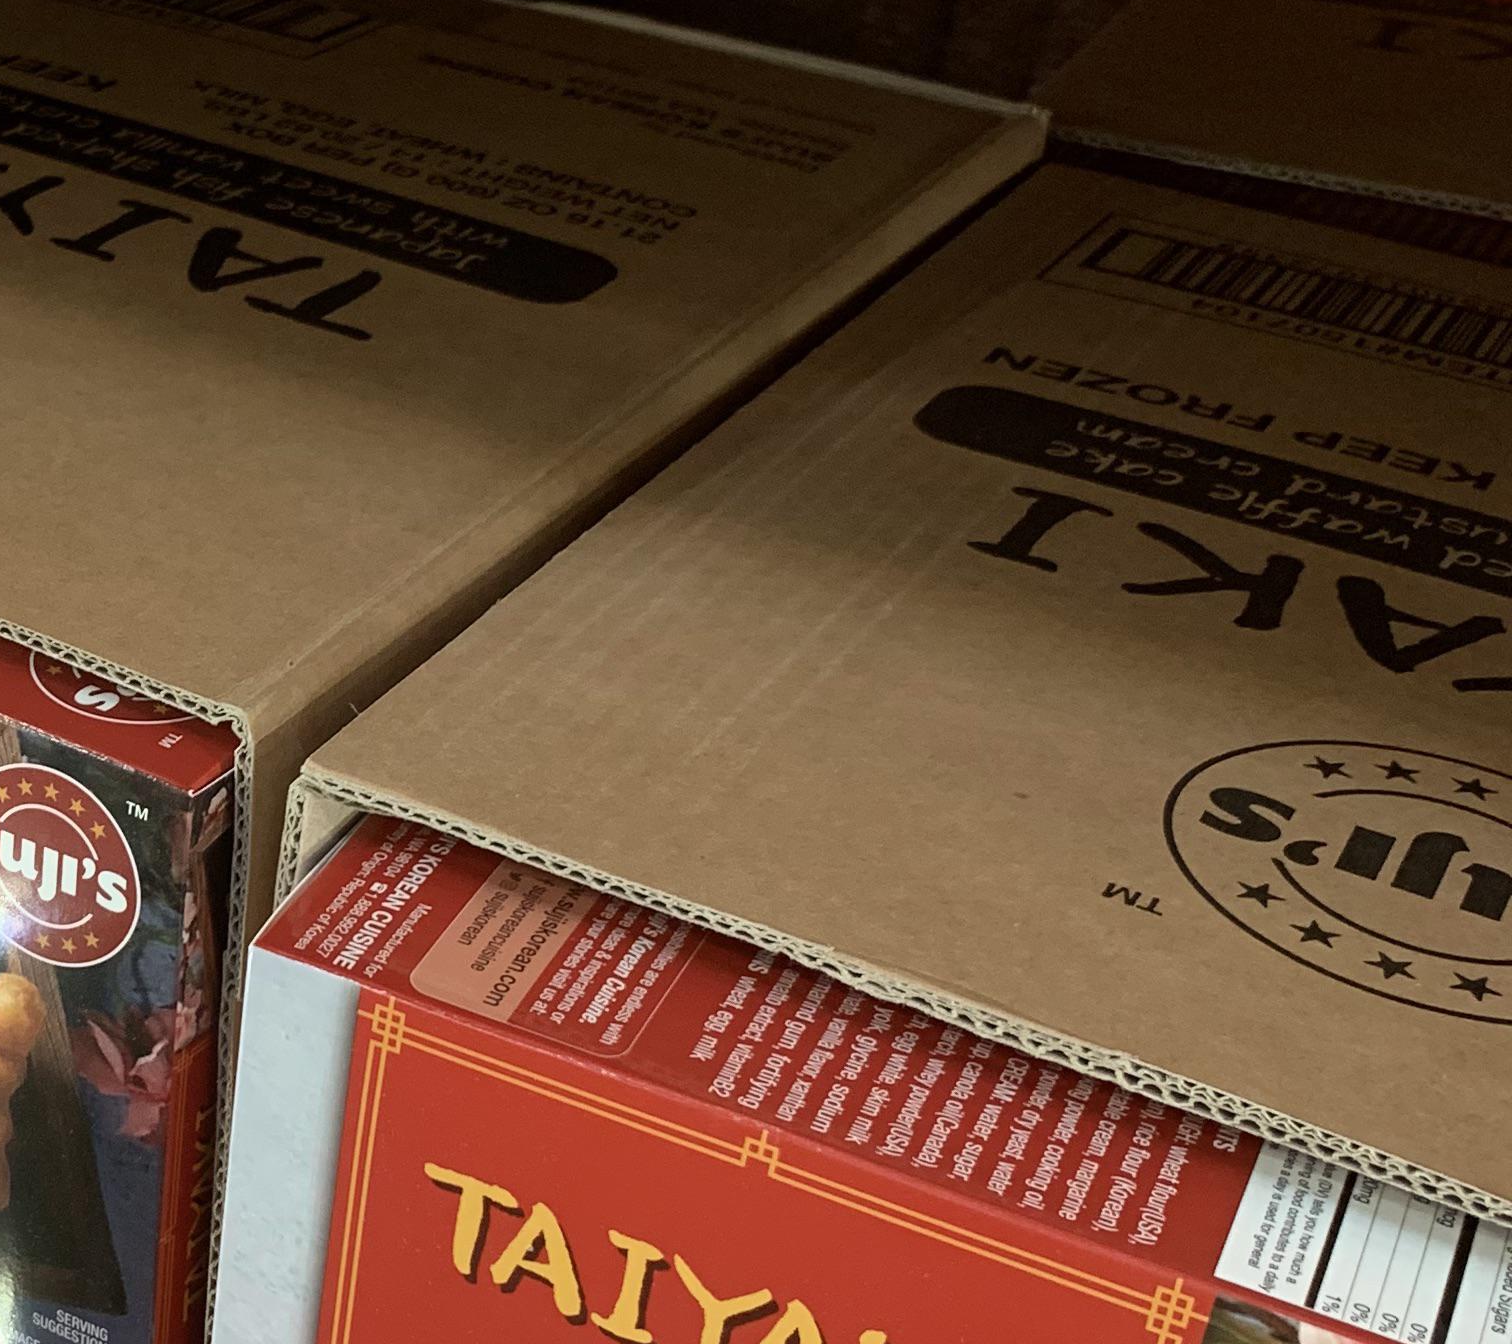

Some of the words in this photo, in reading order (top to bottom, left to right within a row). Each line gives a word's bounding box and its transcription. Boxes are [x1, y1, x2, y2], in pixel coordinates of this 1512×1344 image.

[982, 347, 1276, 433] FROZEN
[1044, 441, 1183, 488] cake
[1075, 419, 1261, 480] cream
[1293, 431, 1497, 493] KEEP
[1207, 482, 1412, 551] waffle
[126, 801, 150, 821] TM
[1199, 787, 1512, 922] uji's
[381, 854, 442, 912] KOREAN
[1101, 881, 1163, 916] TM
[332, 909, 393, 971] CUISINE
[613, 936, 656, 979] Korean
[578, 976, 626, 1024] Cuisine.
[689, 1034, 719, 1062] milk
[707, 1043, 754, 1098] vitaminB2
[737, 1052, 792, 1111] fortifying
[991, 1057, 1030, 1104] CREAM:
[810, 1084, 850, 1134] sodium
[966, 1103, 1003, 1142] water,
[946, 1141, 984, 1183] sugar,
[1025, 1143, 1065, 1187] cooking
[1057, 1158, 1100, 1222] margarine
[1090, 1174, 1138, 1233] (Korean),
[1128, 1182, 1179, 1246] flour(USA),
[56, 1308, 108, 1342] SERVING
